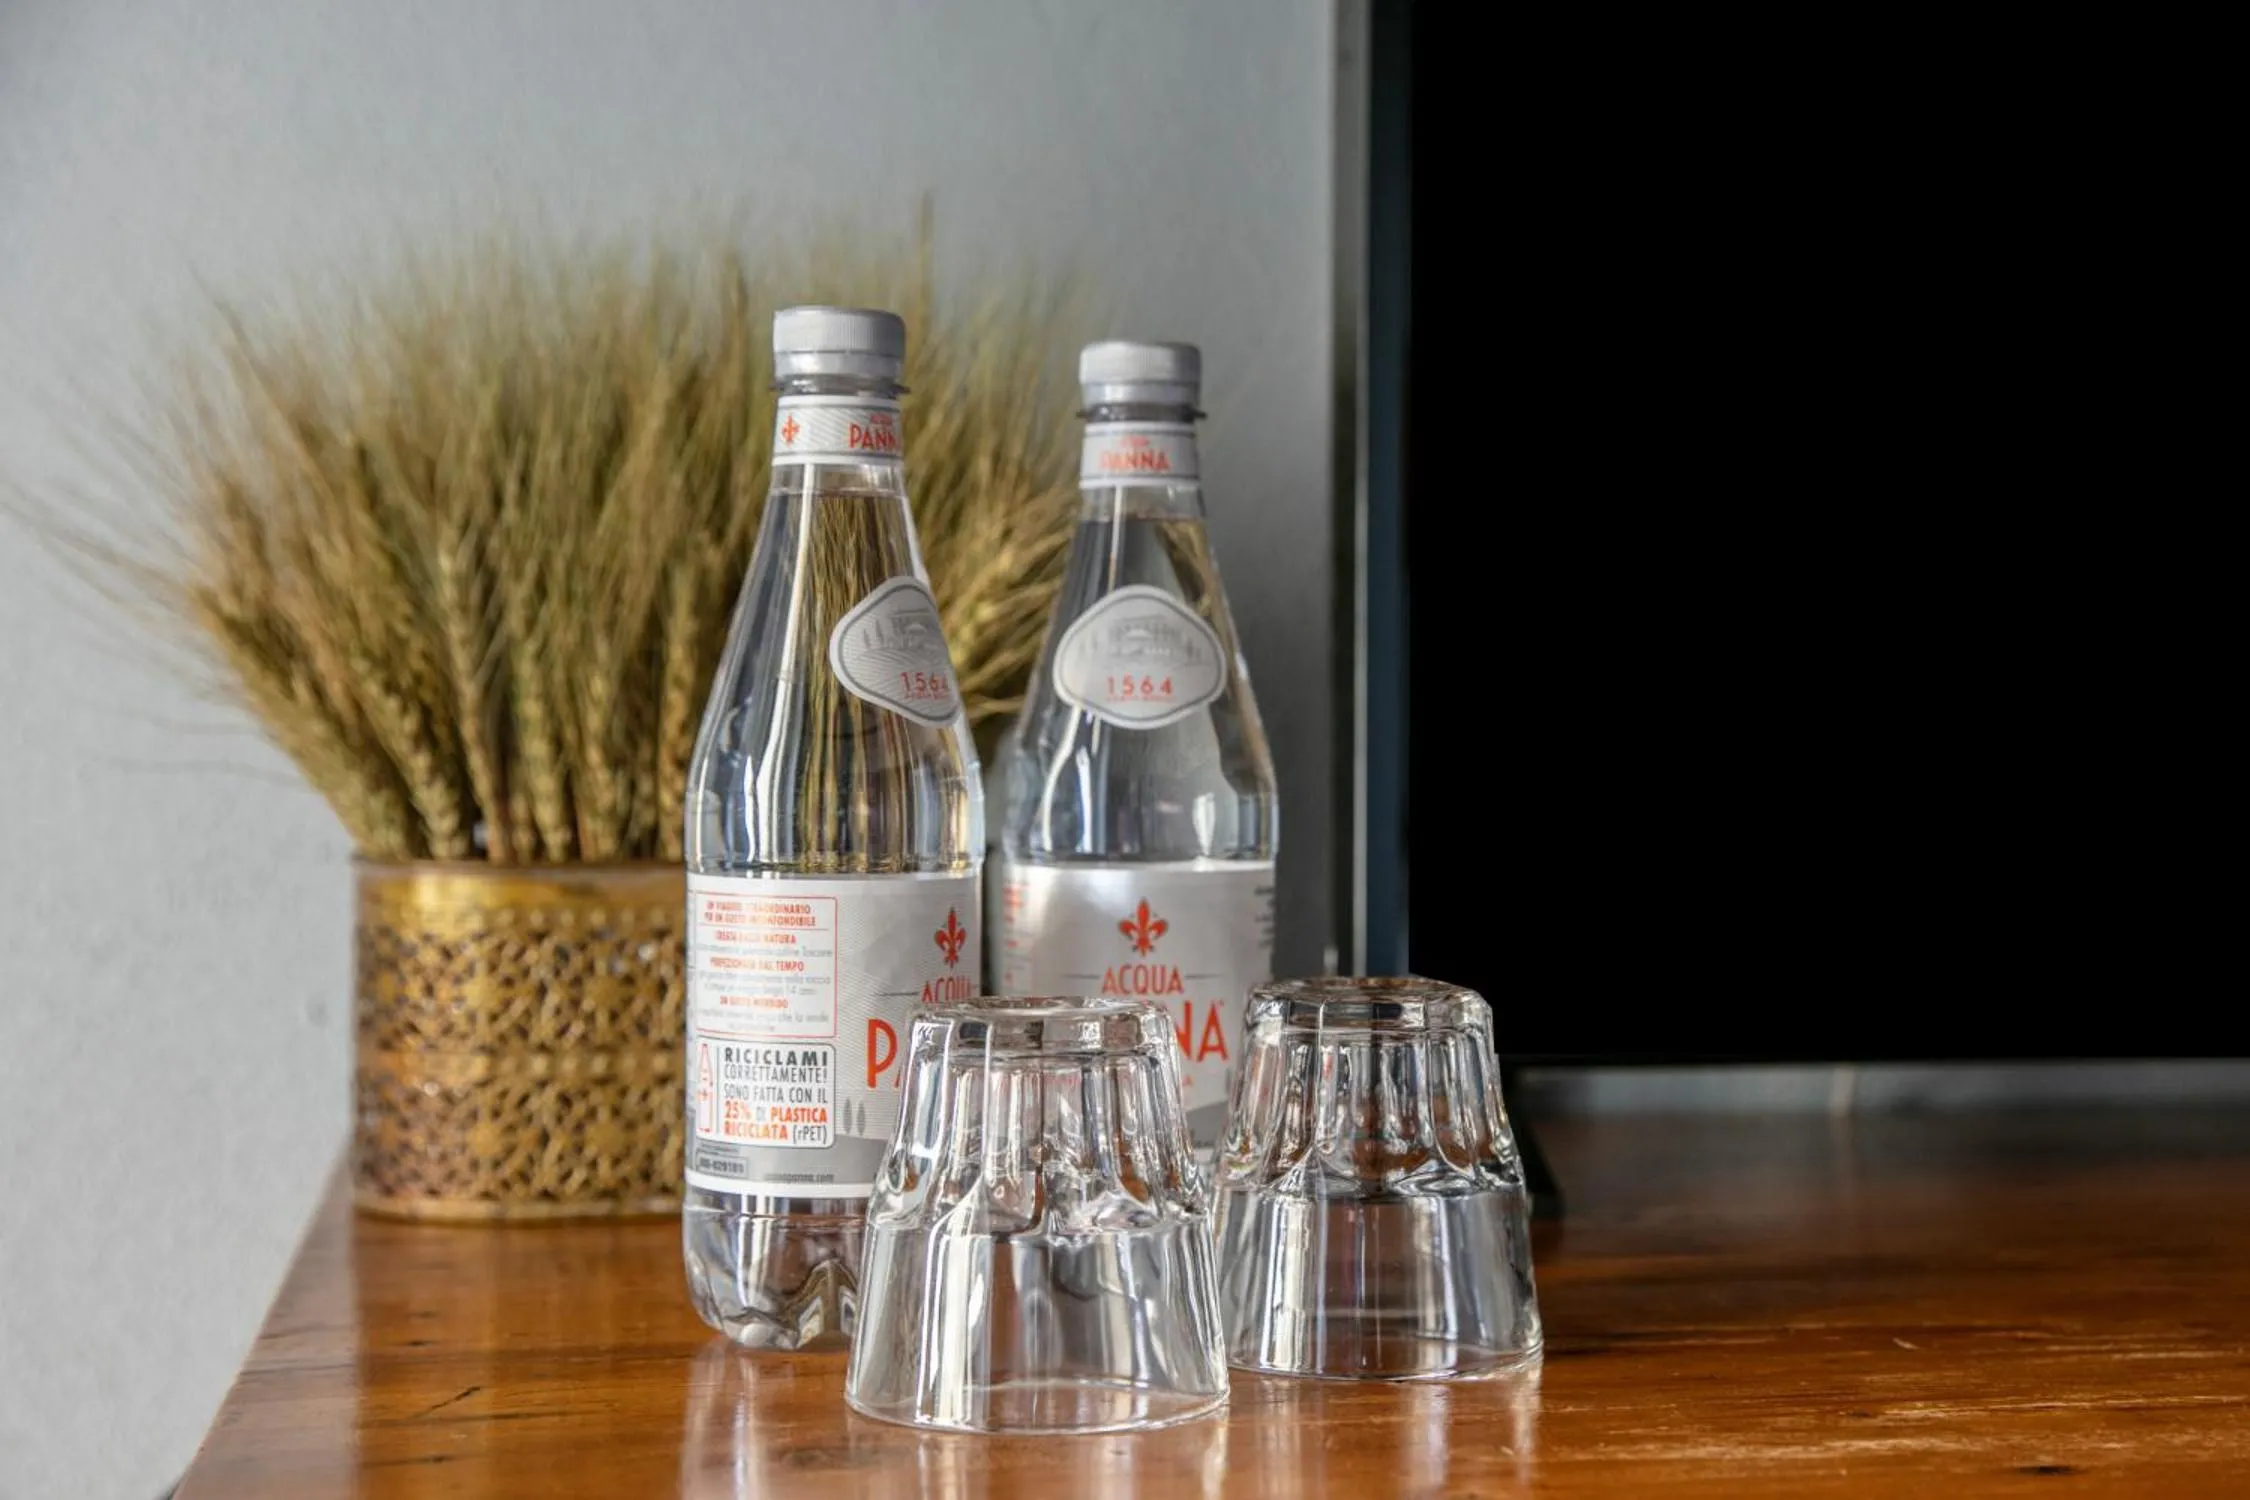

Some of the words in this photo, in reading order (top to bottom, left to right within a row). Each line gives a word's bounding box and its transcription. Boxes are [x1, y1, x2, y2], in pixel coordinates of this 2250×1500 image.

[1107, 674, 1174, 695] 1564
[1102, 963, 1185, 995] ACQUA
[724, 1047, 828, 1067] RICICLAMI
[724, 1063, 828, 1084] CORRETTAMENTE!
[723, 1083, 750, 1101] SONO
[753, 1085, 784, 1103] FATTA
[789, 1087, 813, 1104] CON
[817, 1088, 828, 1104] IL
[724, 1100, 752, 1120] 25%
[770, 1106, 828, 1123] PLASTICA
[724, 1121, 788, 1141] RICICLATA
[792, 1125, 828, 1145] (rPET)
